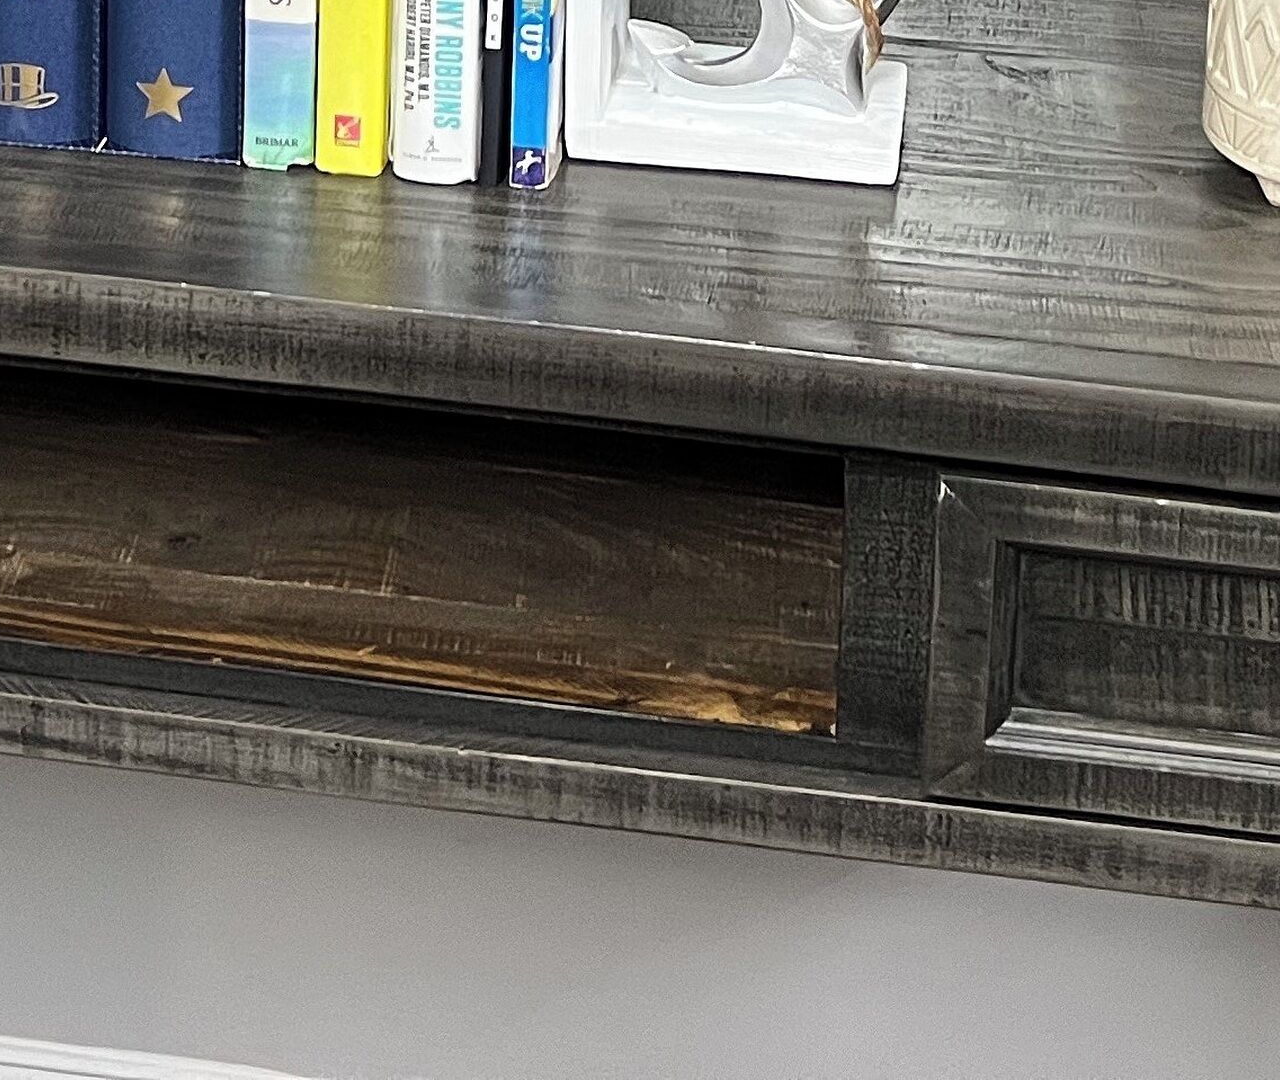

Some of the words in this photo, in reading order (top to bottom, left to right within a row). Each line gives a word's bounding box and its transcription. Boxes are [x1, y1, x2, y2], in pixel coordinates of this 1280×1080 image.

[520, 23, 544, 61] UP
[433, 35, 464, 130] ROBBINS
[255, 136, 299, 149] BRIMAR
